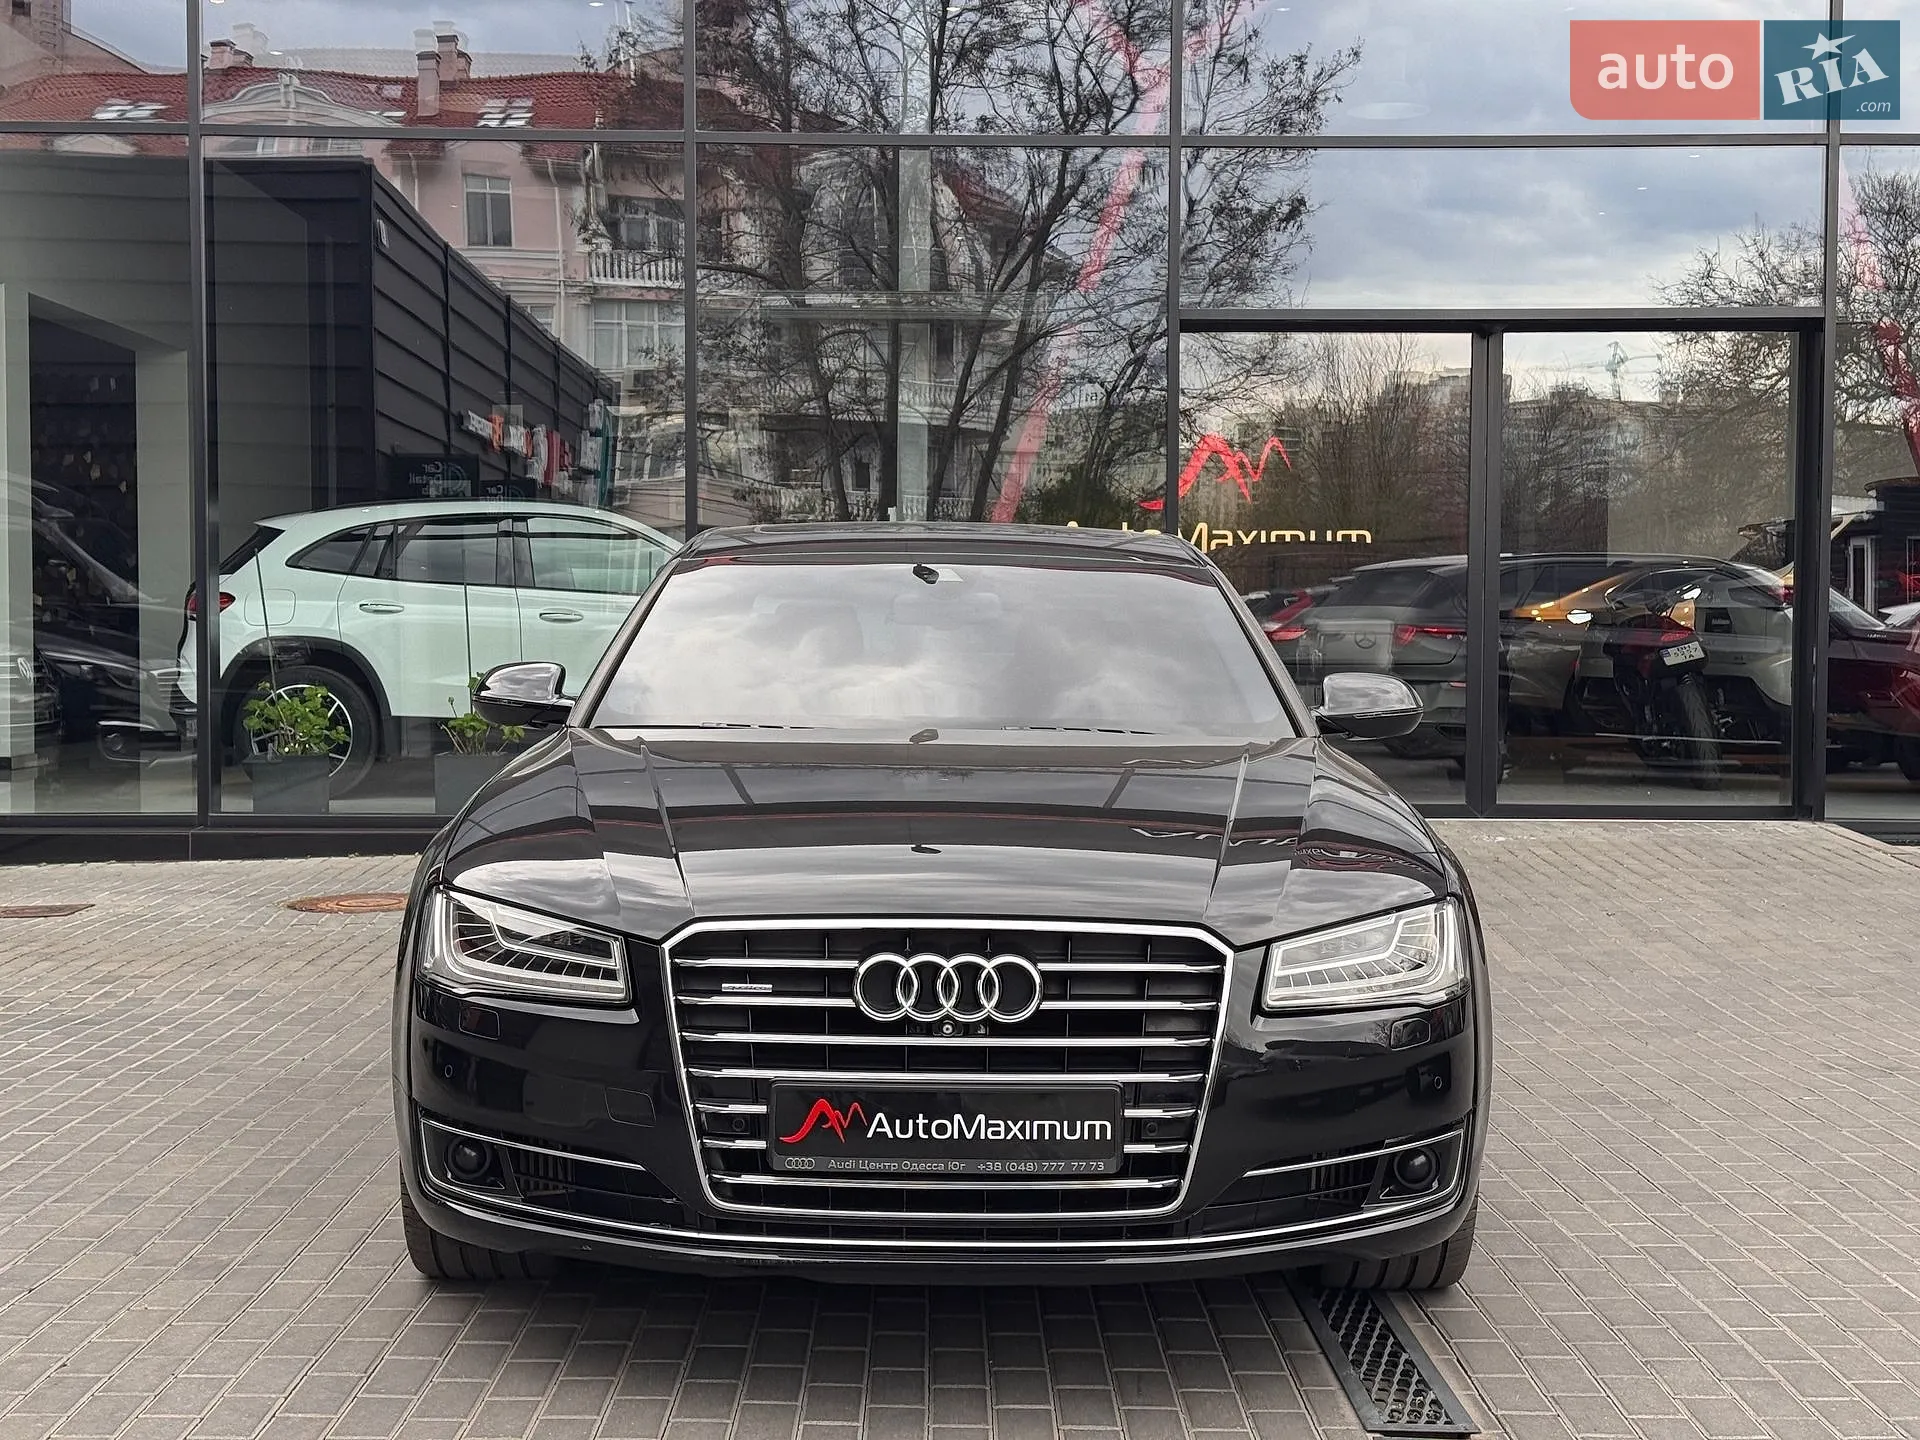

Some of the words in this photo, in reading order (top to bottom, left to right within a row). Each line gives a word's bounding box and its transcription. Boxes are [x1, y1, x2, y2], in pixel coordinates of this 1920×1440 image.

[867, 1112, 1112, 1141] AutoMaximum
[828, 1159, 856, 1169] Audi
[859, 1160, 899, 1172] Центр
[901, 1161, 945, 1172] Одесса
[948, 1161, 966, 1171] Юг
[977, 1162, 1002, 1172] +38
[1005, 1162, 1038, 1173] (048)
[1041, 1162, 1065, 1172] 777
[1071, 1162, 1087, 1172] 77
[1089, 1162, 1105, 1172] 73
